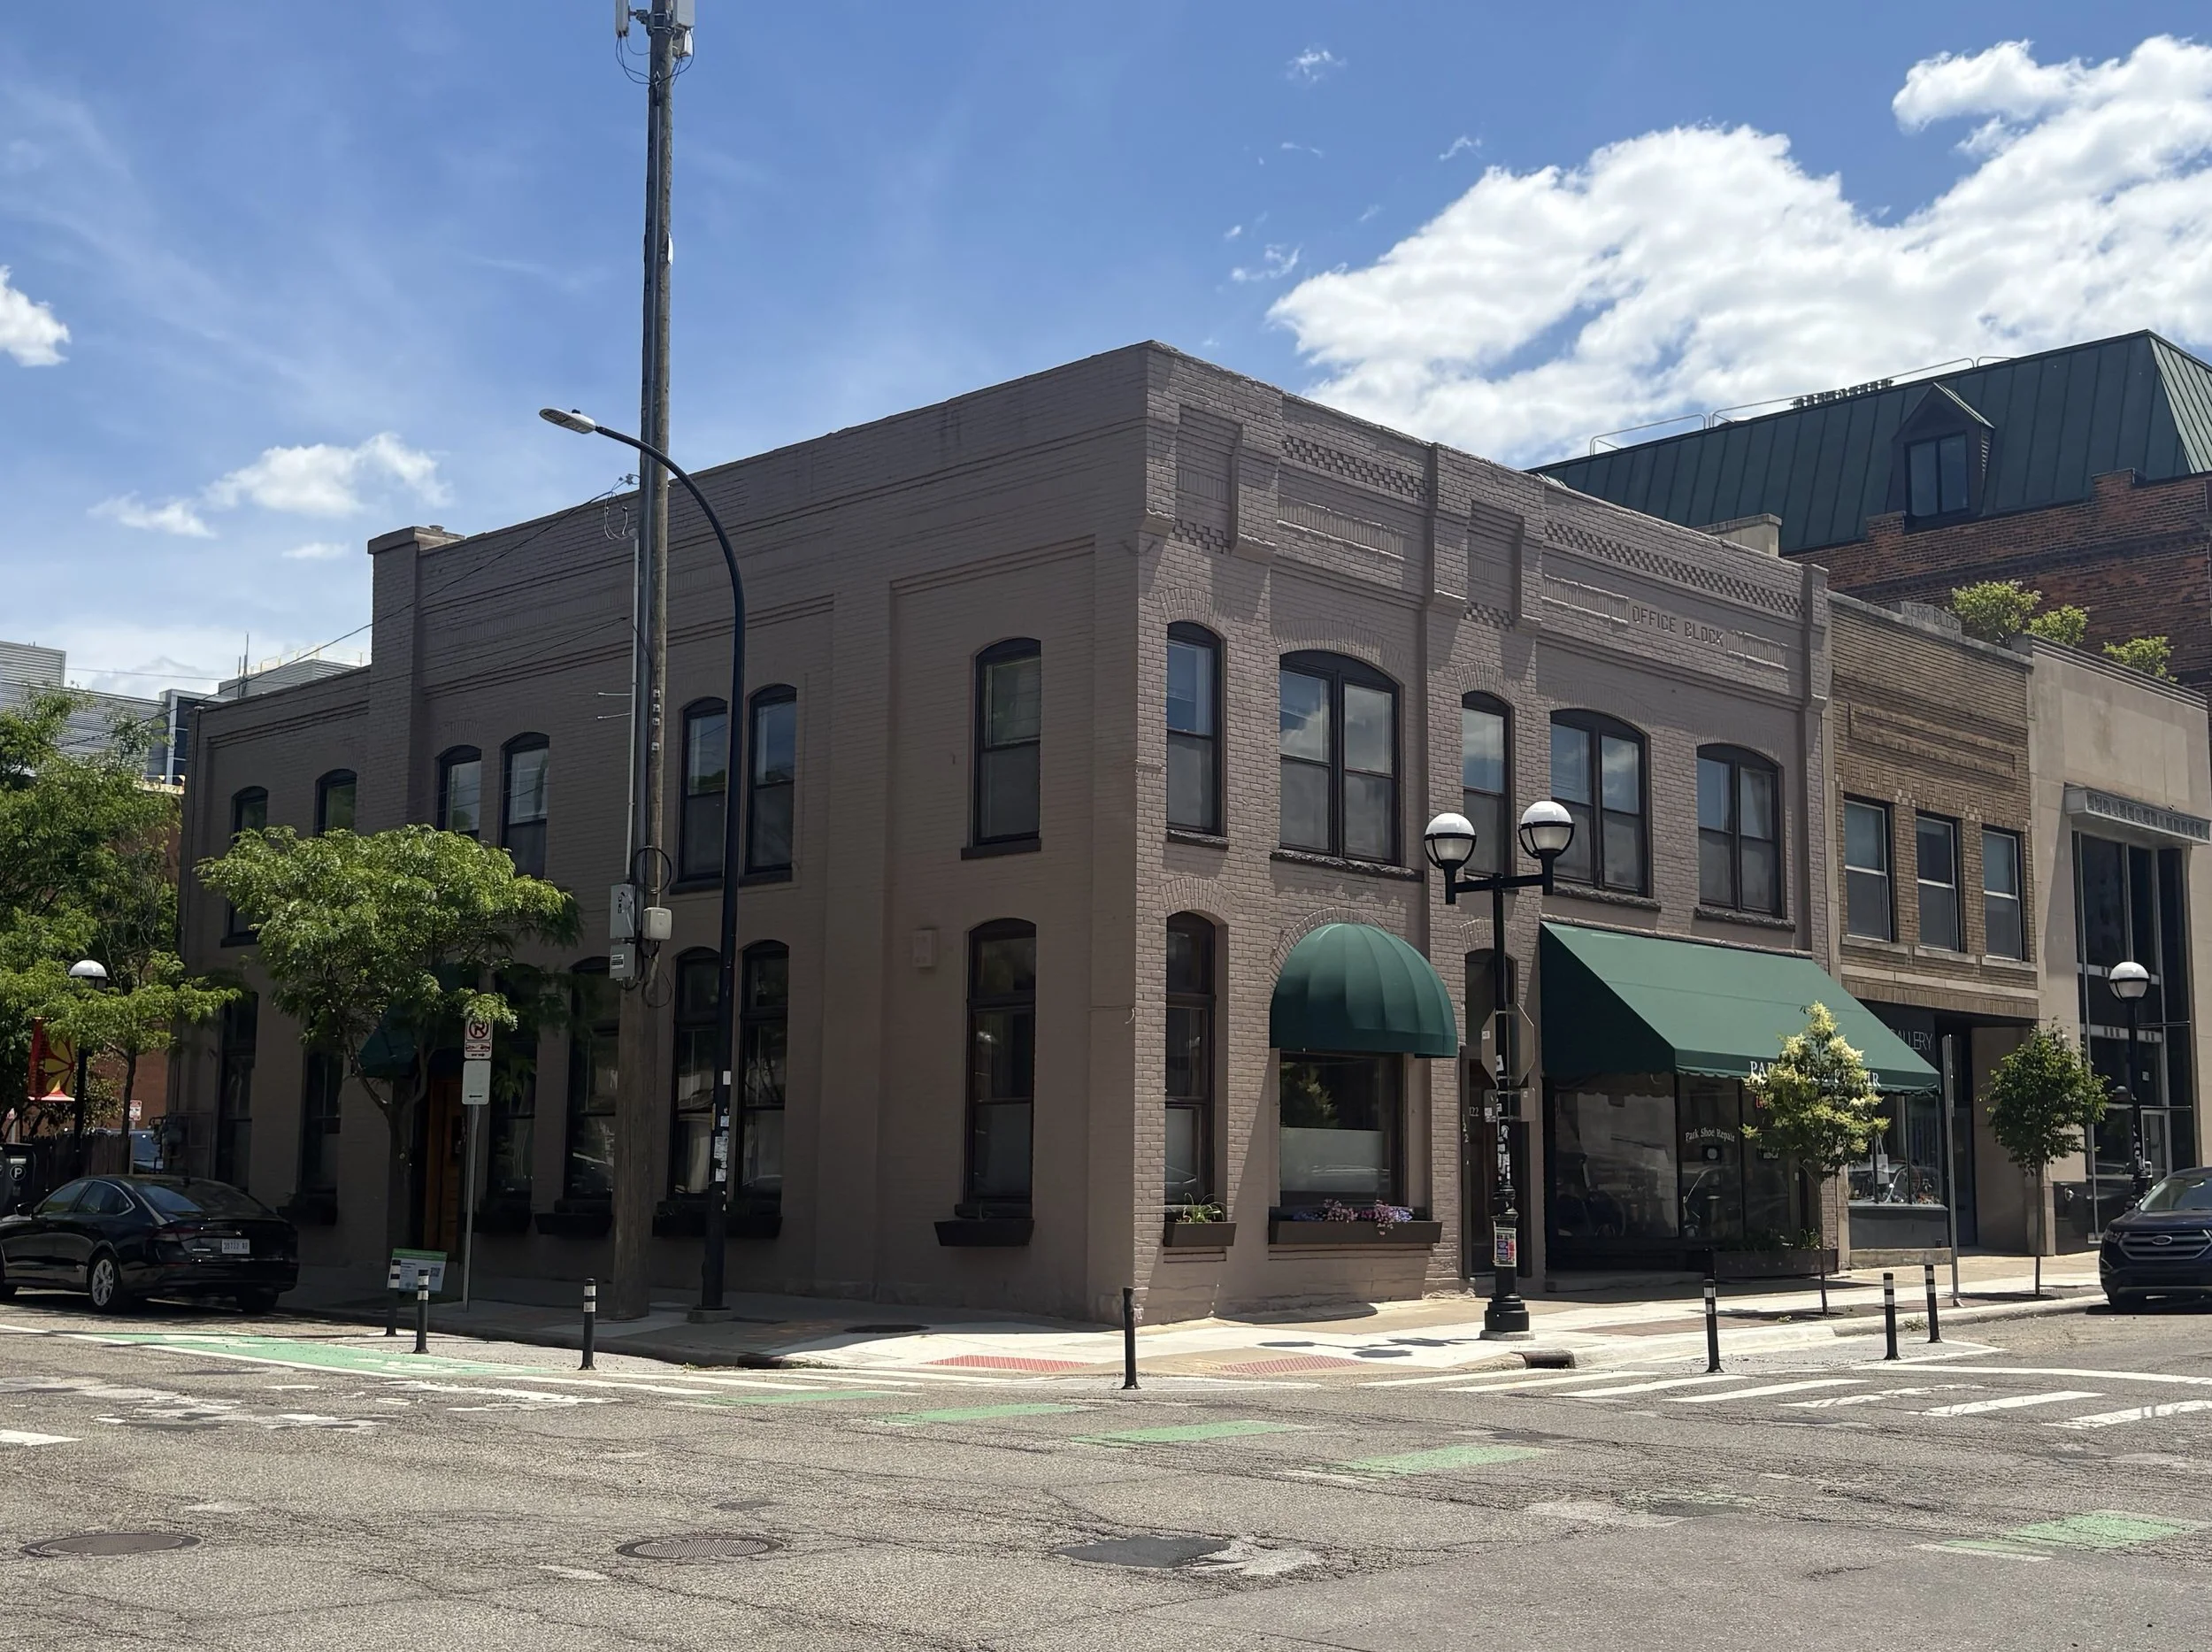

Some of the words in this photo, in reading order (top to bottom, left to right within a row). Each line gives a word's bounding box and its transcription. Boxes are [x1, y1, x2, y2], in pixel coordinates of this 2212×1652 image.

[1632, 605, 1678, 634] OFFICE
[1684, 621, 1724, 647] BLOCK
[1685, 1128, 1699, 1141] Park
[1700, 1127, 1715, 1138] Shoe
[1716, 1128, 1735, 1142] Repair
